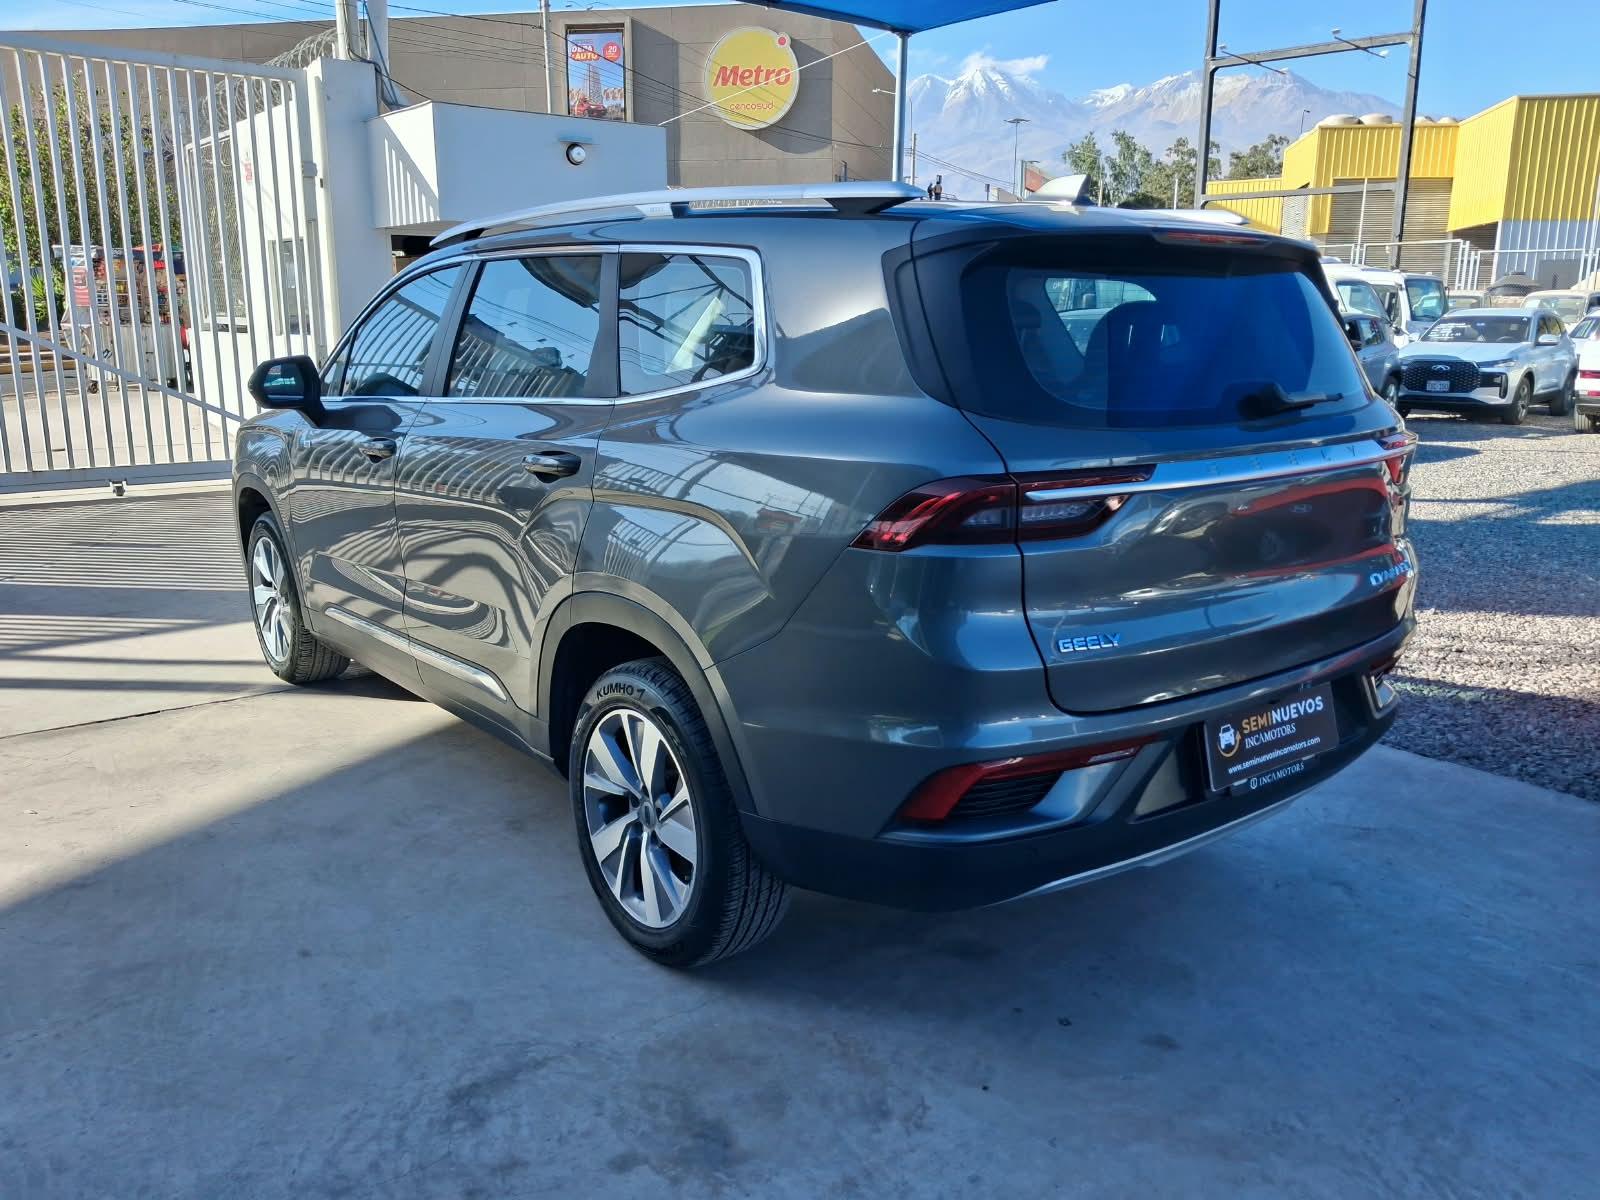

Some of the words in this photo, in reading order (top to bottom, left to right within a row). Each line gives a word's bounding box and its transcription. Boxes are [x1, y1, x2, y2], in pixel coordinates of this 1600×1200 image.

[713, 64, 791, 87] Metro
[729, 100, 774, 111] cencosud
[1058, 633, 1120, 653] GEELY
[596, 682, 634, 700] KUMHO
[1241, 695, 1324, 734] SEMINUEVOS
[1244, 722, 1297, 749] INCAMOTORS
[1227, 736, 1321, 774] www.seminuevosincamotors.com
[1259, 762, 1305, 786] INCAMOTORS
